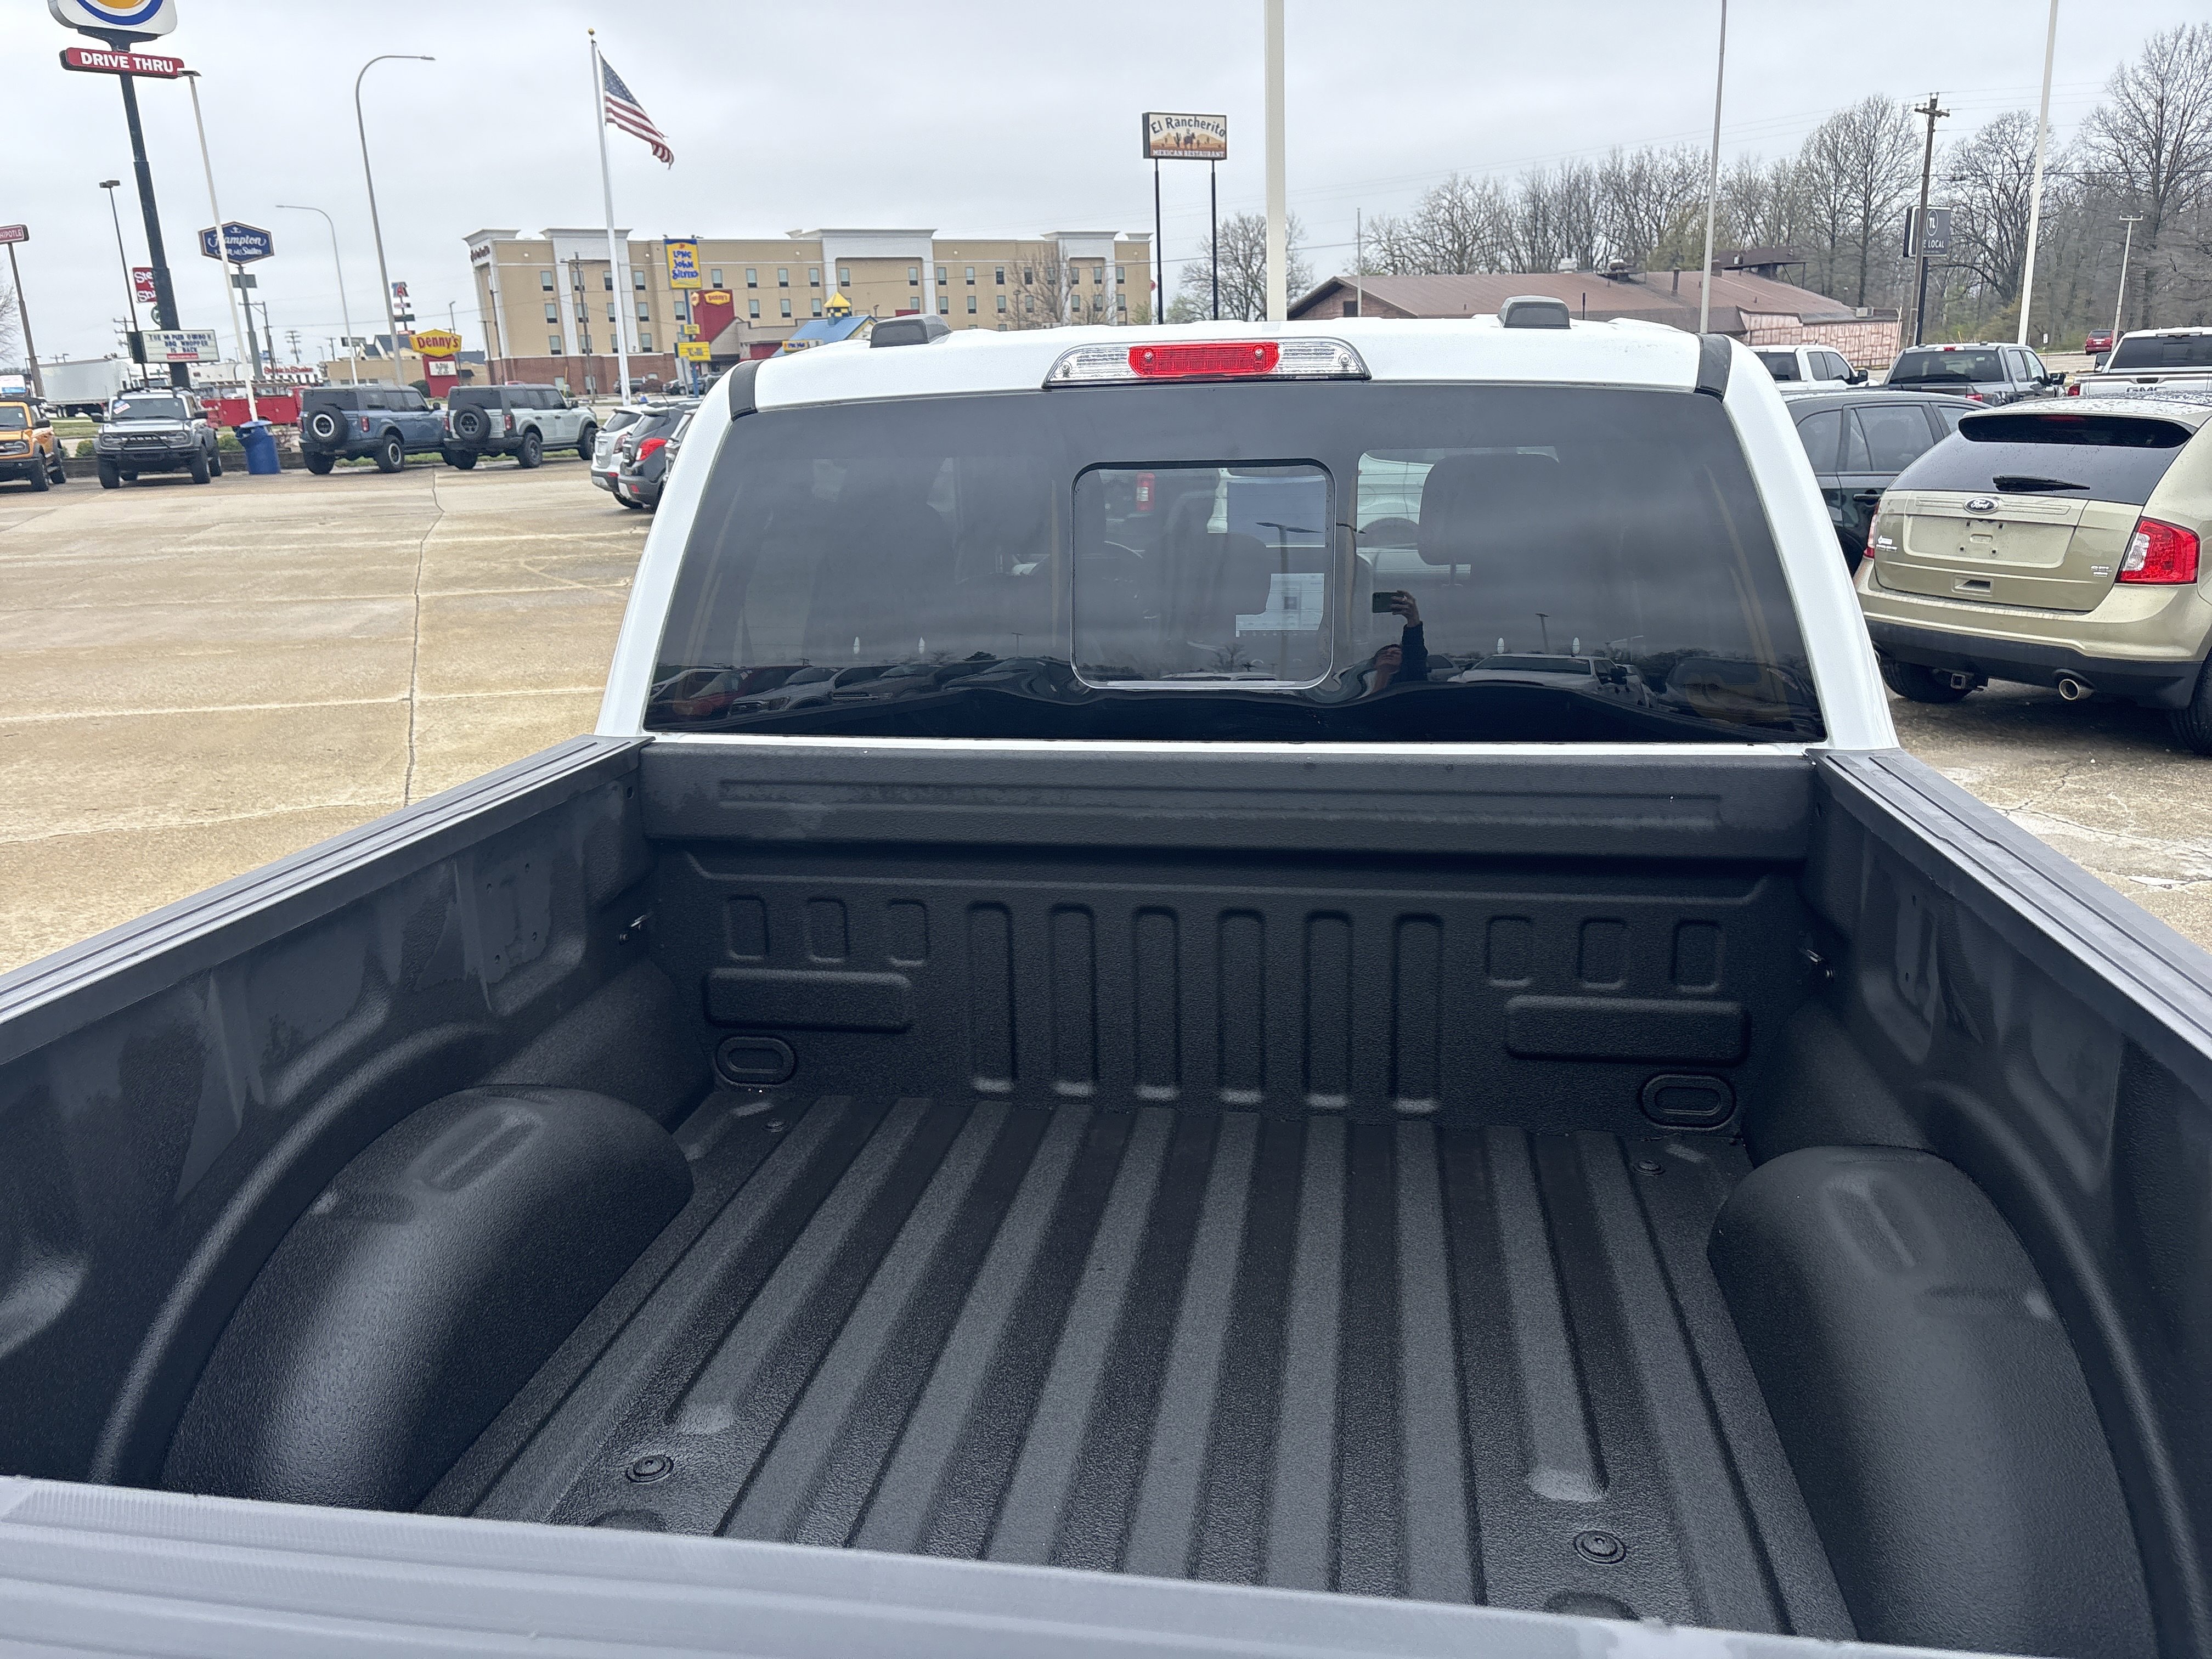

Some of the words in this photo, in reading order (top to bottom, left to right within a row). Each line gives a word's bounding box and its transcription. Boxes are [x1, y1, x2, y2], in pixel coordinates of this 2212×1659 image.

[80, 52, 130, 69] DRIVE
[133, 57, 173, 72] THRU
[1150, 120, 1163, 134] El
[1165, 116, 1226, 137] Rancherito
[0, 229, 22, 238] HIPOTLE
[1928, 239, 1944, 249] LOCAL
[674, 259, 693, 268] JOHN
[134, 271, 154, 284] Ste
[416, 335, 459, 349] Denny's
[1970, 499, 1990, 509] Ford
